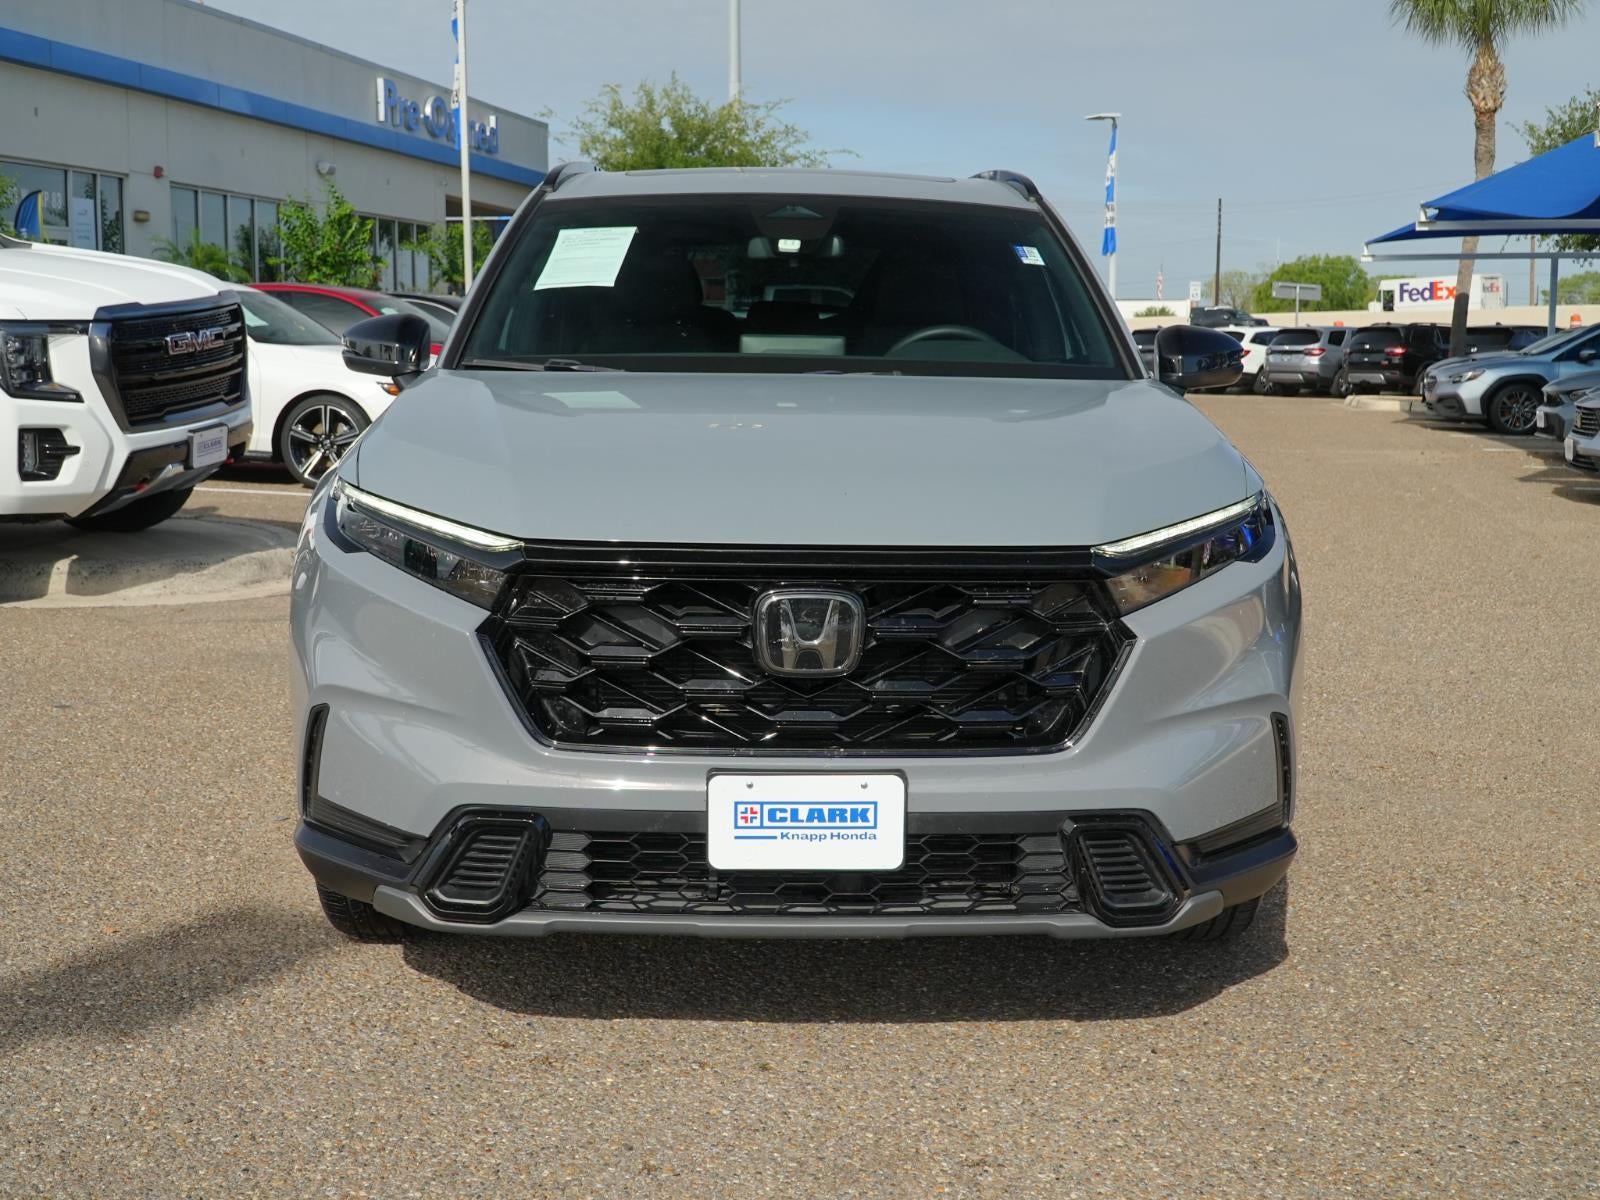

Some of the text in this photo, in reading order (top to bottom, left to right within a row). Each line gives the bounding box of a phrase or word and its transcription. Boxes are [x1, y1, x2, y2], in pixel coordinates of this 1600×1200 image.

[1399, 281, 1457, 302] FedEx
[167, 327, 225, 355] GMC
[767, 807, 871, 823] CLARK
[780, 831, 877, 842] Knapp Honda
